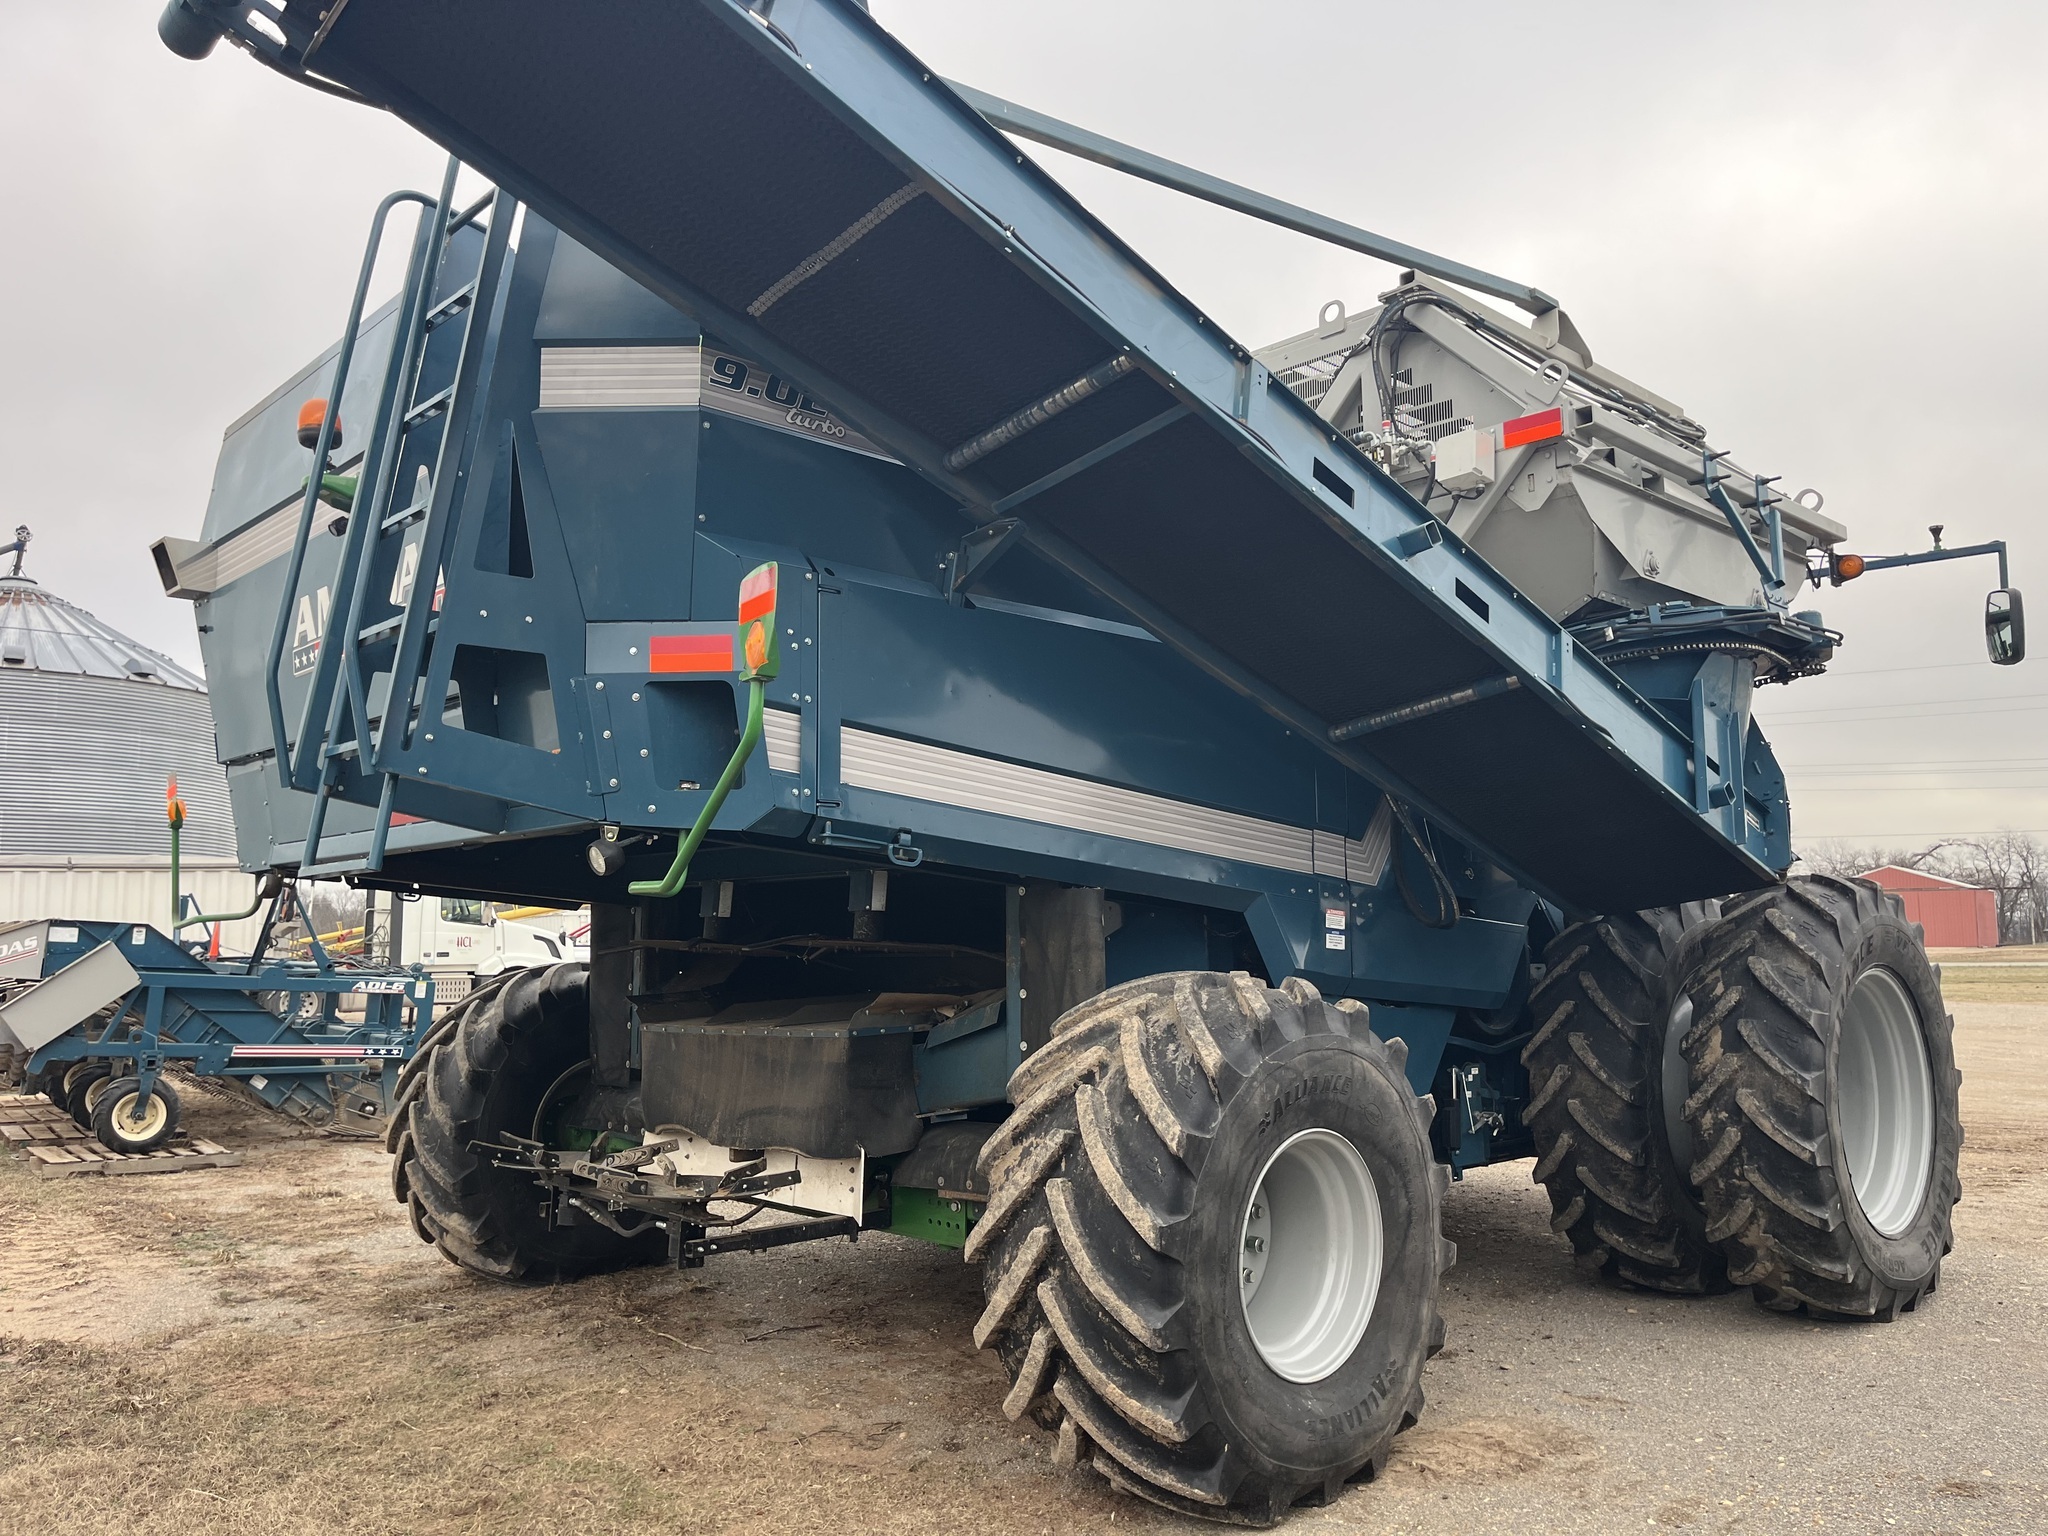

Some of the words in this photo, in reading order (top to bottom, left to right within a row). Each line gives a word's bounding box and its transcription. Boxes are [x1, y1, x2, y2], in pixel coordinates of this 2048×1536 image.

[784, 407, 846, 439] turbo
[1272, 1074, 1353, 1127] ALLIANCE
[1307, 1373, 1388, 1442] ALLIANCE
